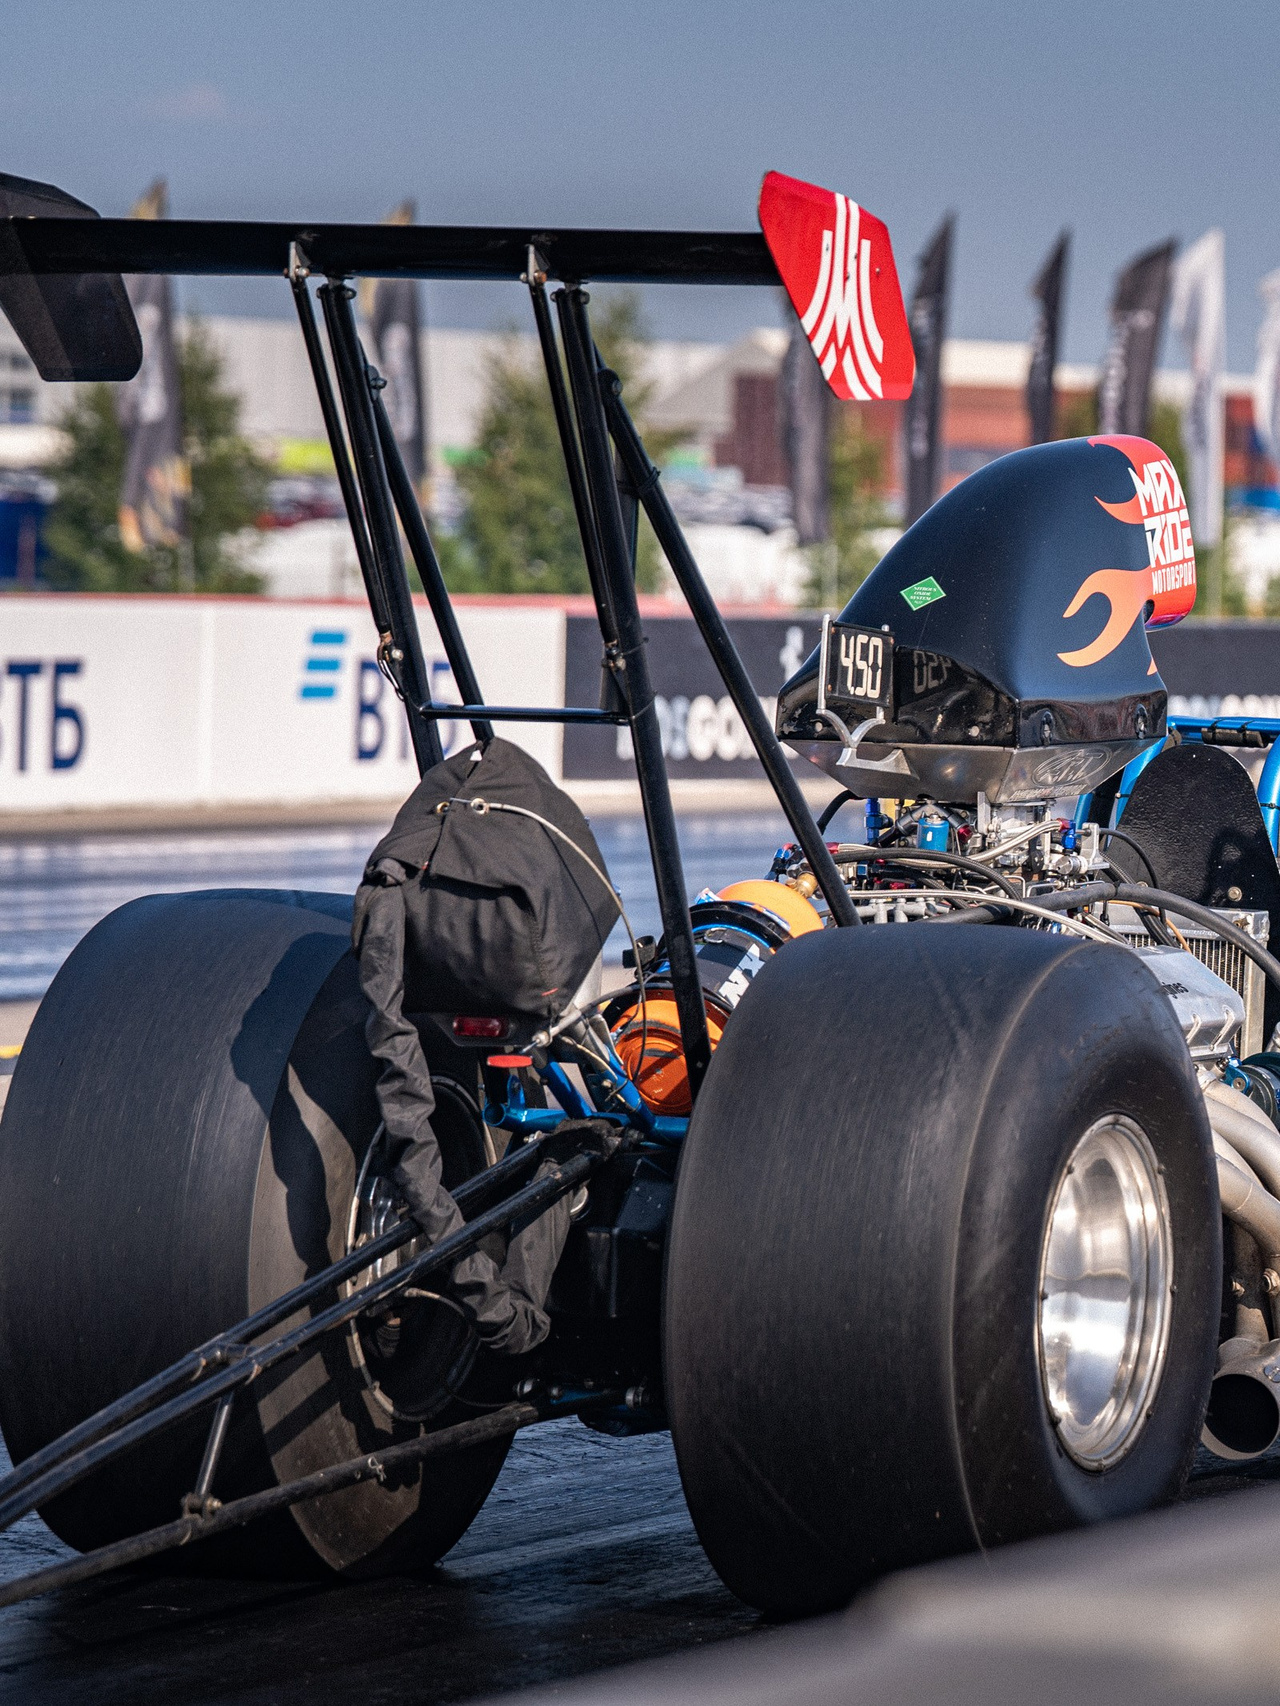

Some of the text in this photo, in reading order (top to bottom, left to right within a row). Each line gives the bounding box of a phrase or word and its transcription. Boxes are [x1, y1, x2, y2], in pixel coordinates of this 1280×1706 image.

[1128, 459, 1187, 516] MAX
[1143, 508, 1195, 568] RIDE
[1152, 560, 1196, 595] MOTORSPORT
[841, 633, 883, 699] 4.50
[0, 657, 86, 772] ТБ
